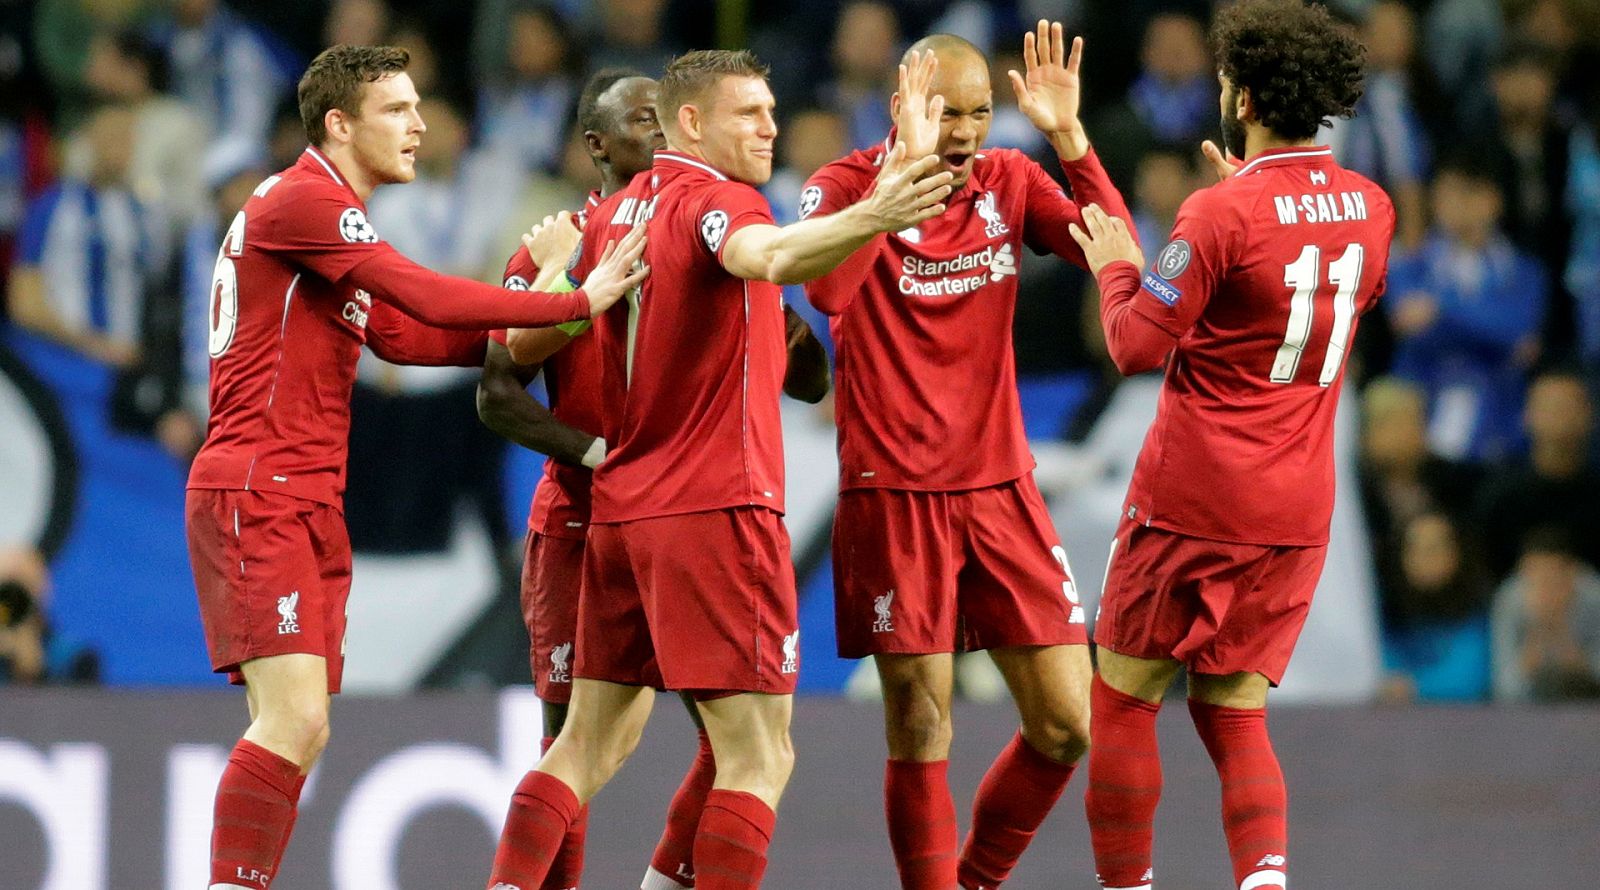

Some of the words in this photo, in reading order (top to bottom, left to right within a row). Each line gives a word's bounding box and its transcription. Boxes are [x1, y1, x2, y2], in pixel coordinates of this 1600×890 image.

[902, 246, 992, 276] Standard
[898, 271, 987, 296] Chartered
[1144, 275, 1179, 302] RESPECT
[1269, 243, 1364, 387] 11
